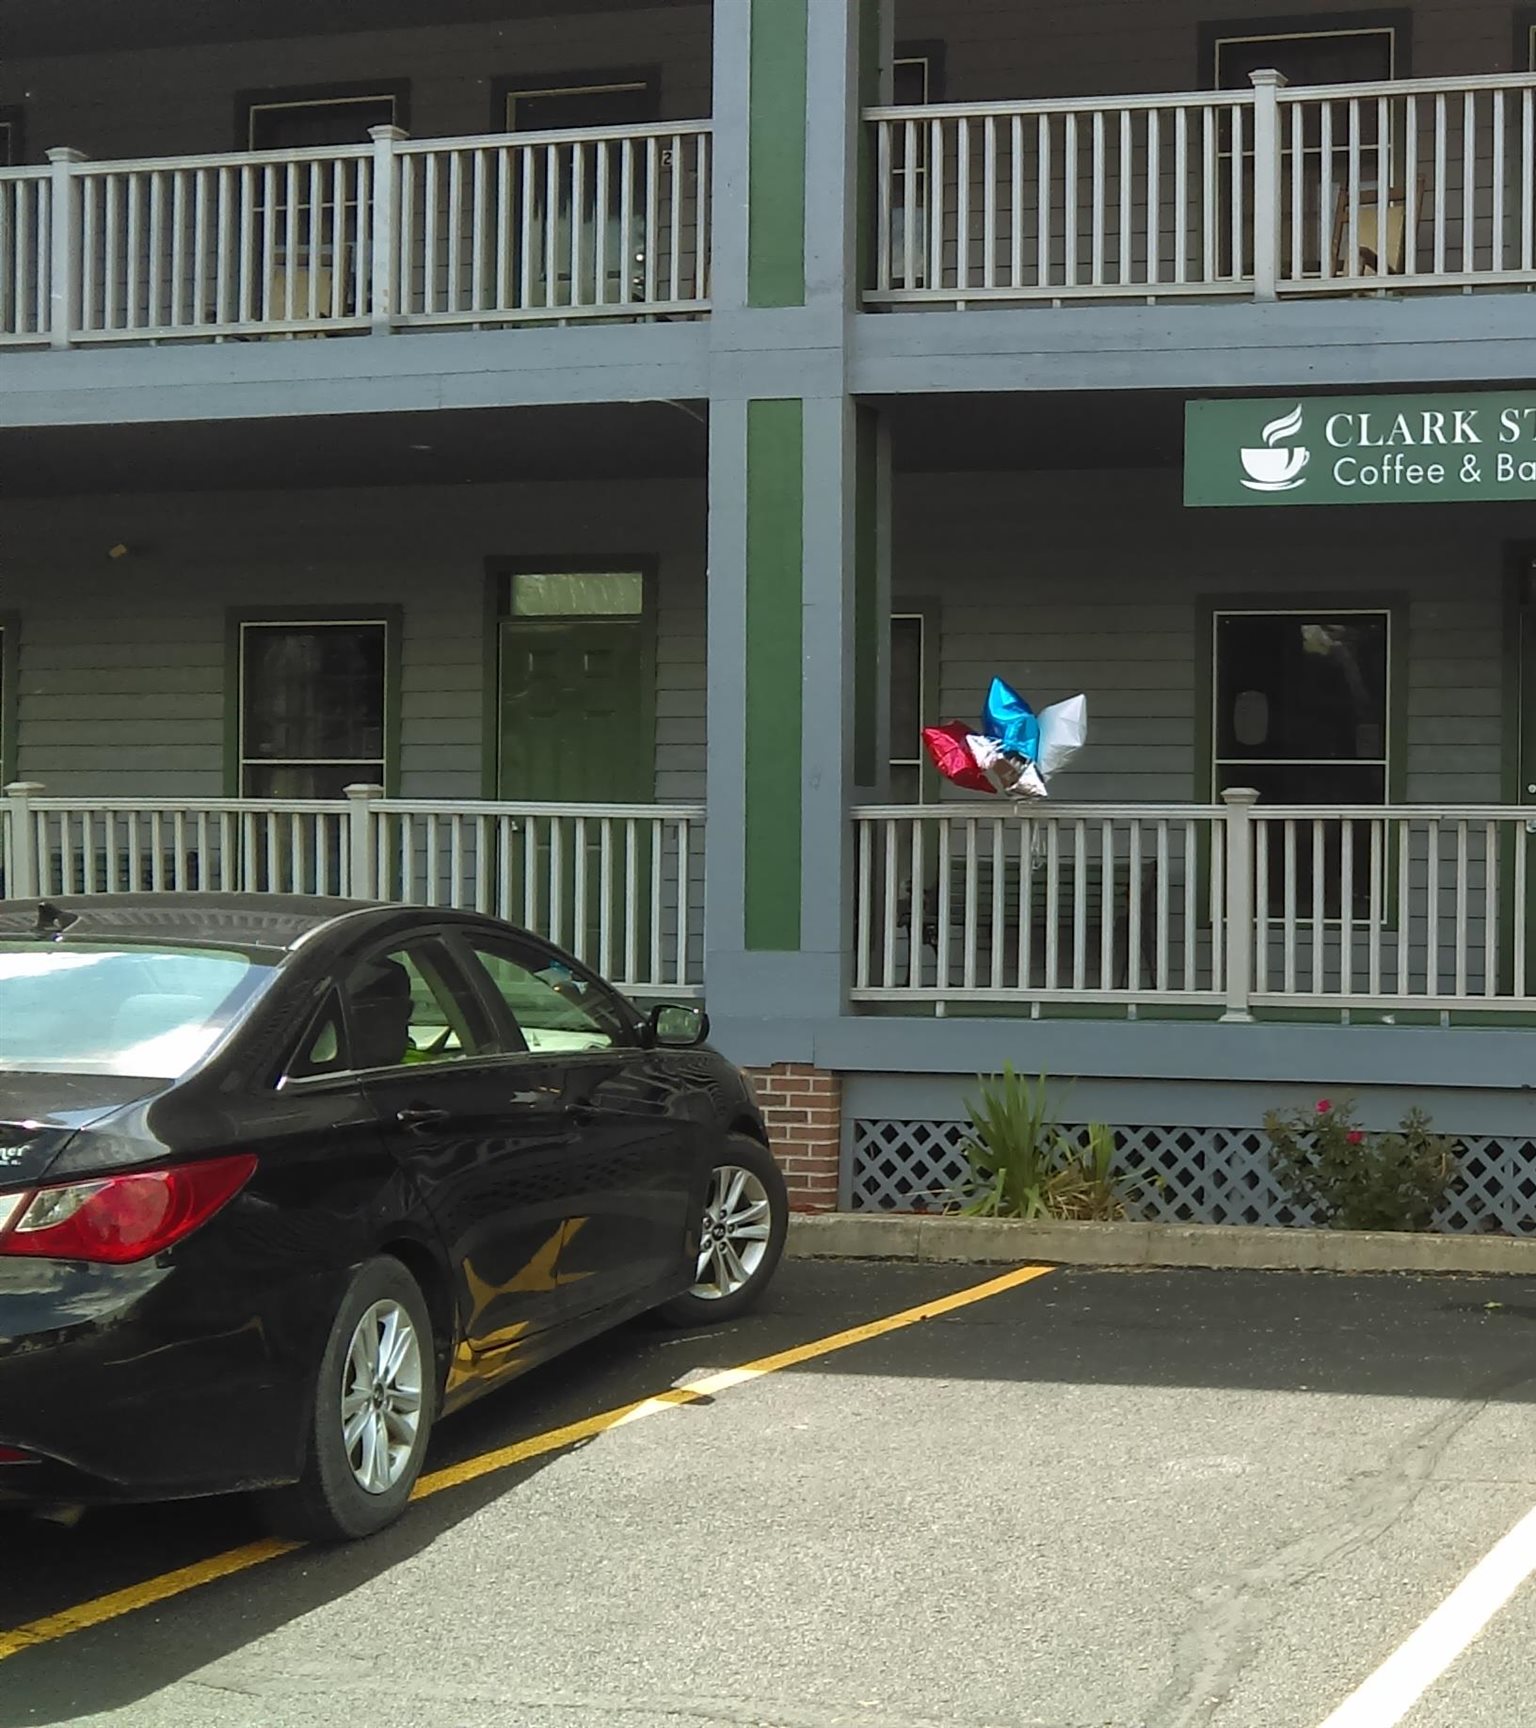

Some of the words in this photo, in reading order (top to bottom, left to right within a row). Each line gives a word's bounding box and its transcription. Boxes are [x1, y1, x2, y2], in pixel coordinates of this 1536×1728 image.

[1324, 409, 1483, 447] CLARK
[1332, 453, 1446, 486] Coffee
[1459, 454, 1482, 483] &
